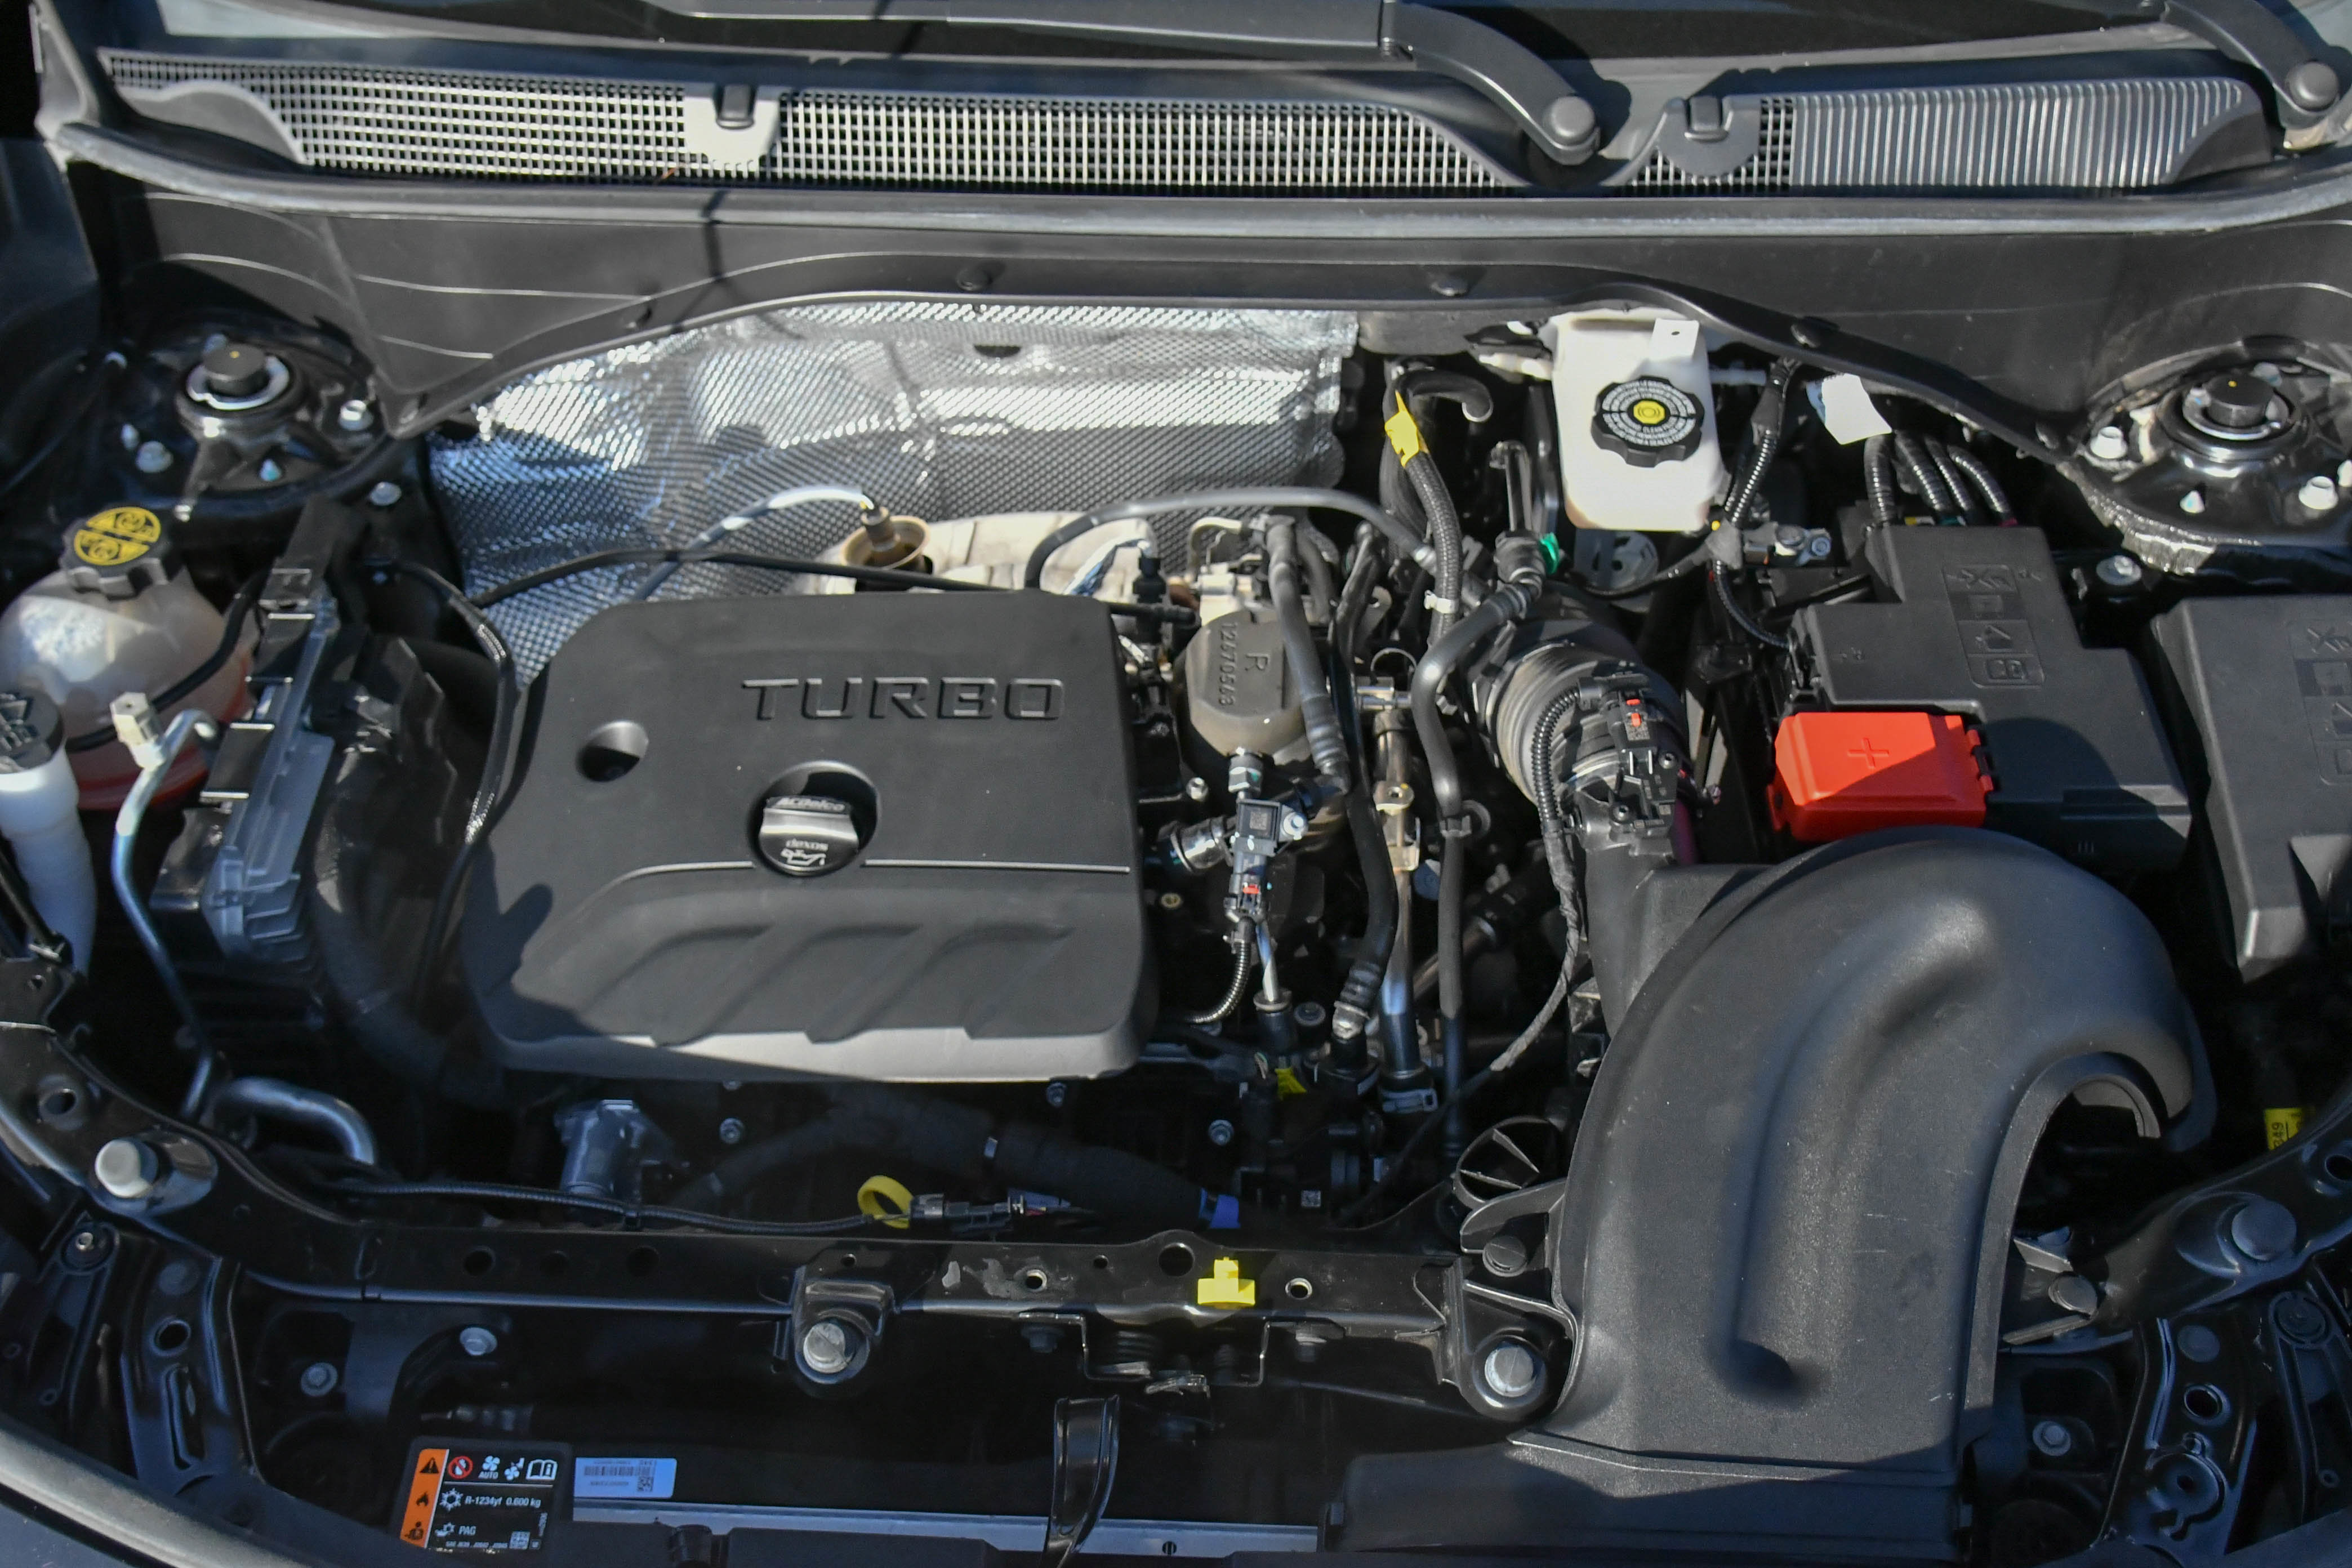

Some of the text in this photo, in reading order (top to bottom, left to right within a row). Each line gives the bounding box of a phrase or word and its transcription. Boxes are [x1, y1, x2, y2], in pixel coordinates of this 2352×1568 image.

[1245, 652, 1270, 670] R
[741, 676, 1065, 720] TURBO
[785, 839, 829, 852] dexos
[478, 1471, 499, 1480] AUTO
[465, 1495, 503, 1507] R-1234yf
[530, 1498, 542, 1509] kg
[458, 1526, 476, 1535] PAG
